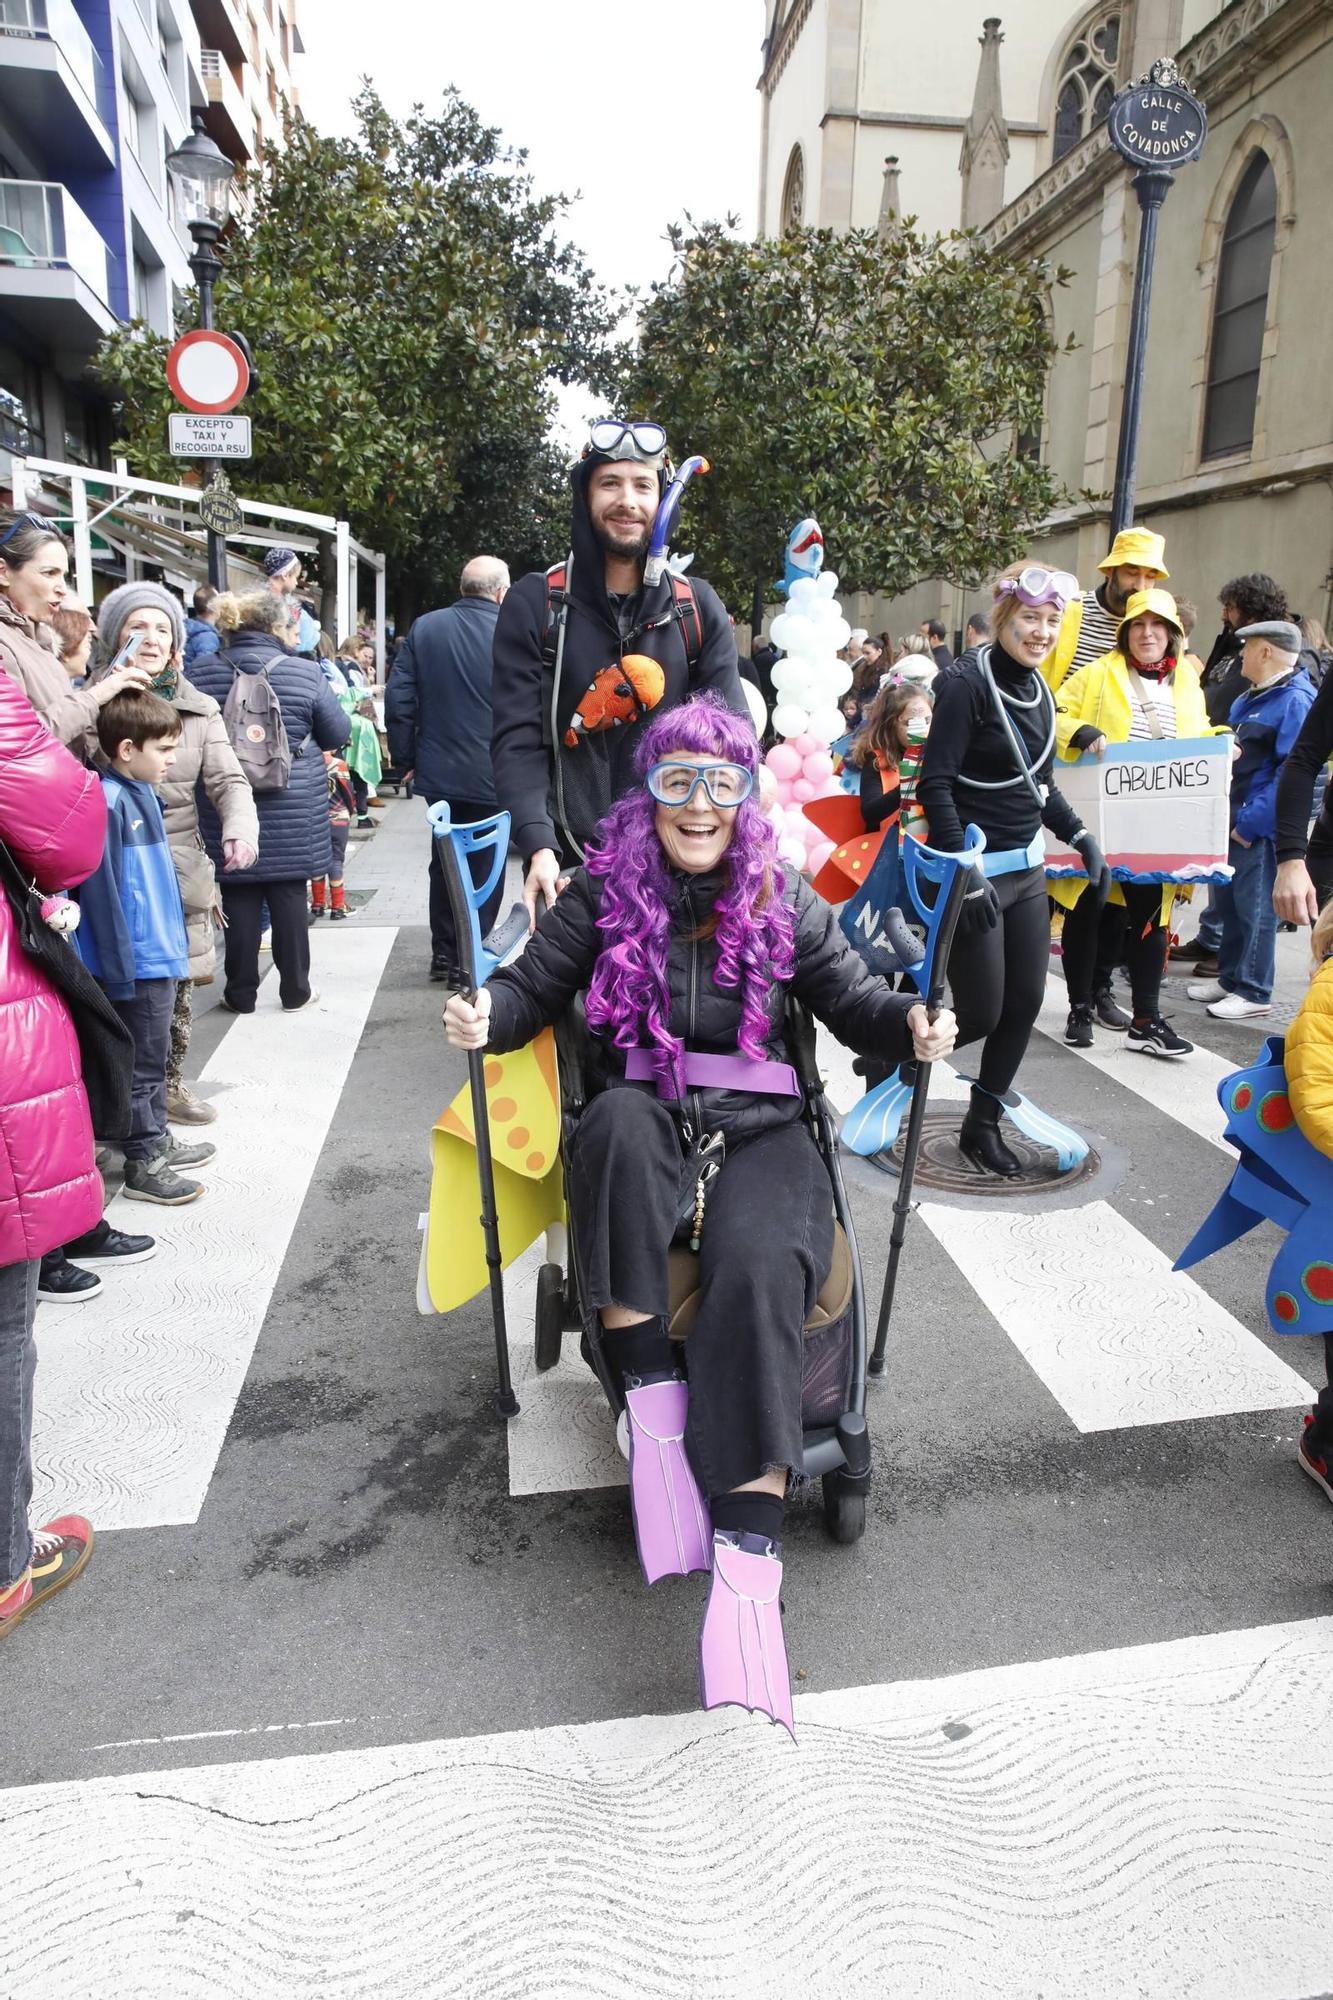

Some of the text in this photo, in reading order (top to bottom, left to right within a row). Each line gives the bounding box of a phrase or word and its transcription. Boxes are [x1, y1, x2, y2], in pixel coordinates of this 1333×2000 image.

[1141, 97, 1182, 114] CALLE
[1151, 120, 1168, 132] DE
[1122, 123, 1196, 155] COVADONGA
[185, 419, 234, 429] EXCEPTO
[193, 431, 227, 441] TAXI Y
[175, 442, 246, 454] RECOGIDA RSU
[1105, 760, 1209, 795] CABUEÑES
